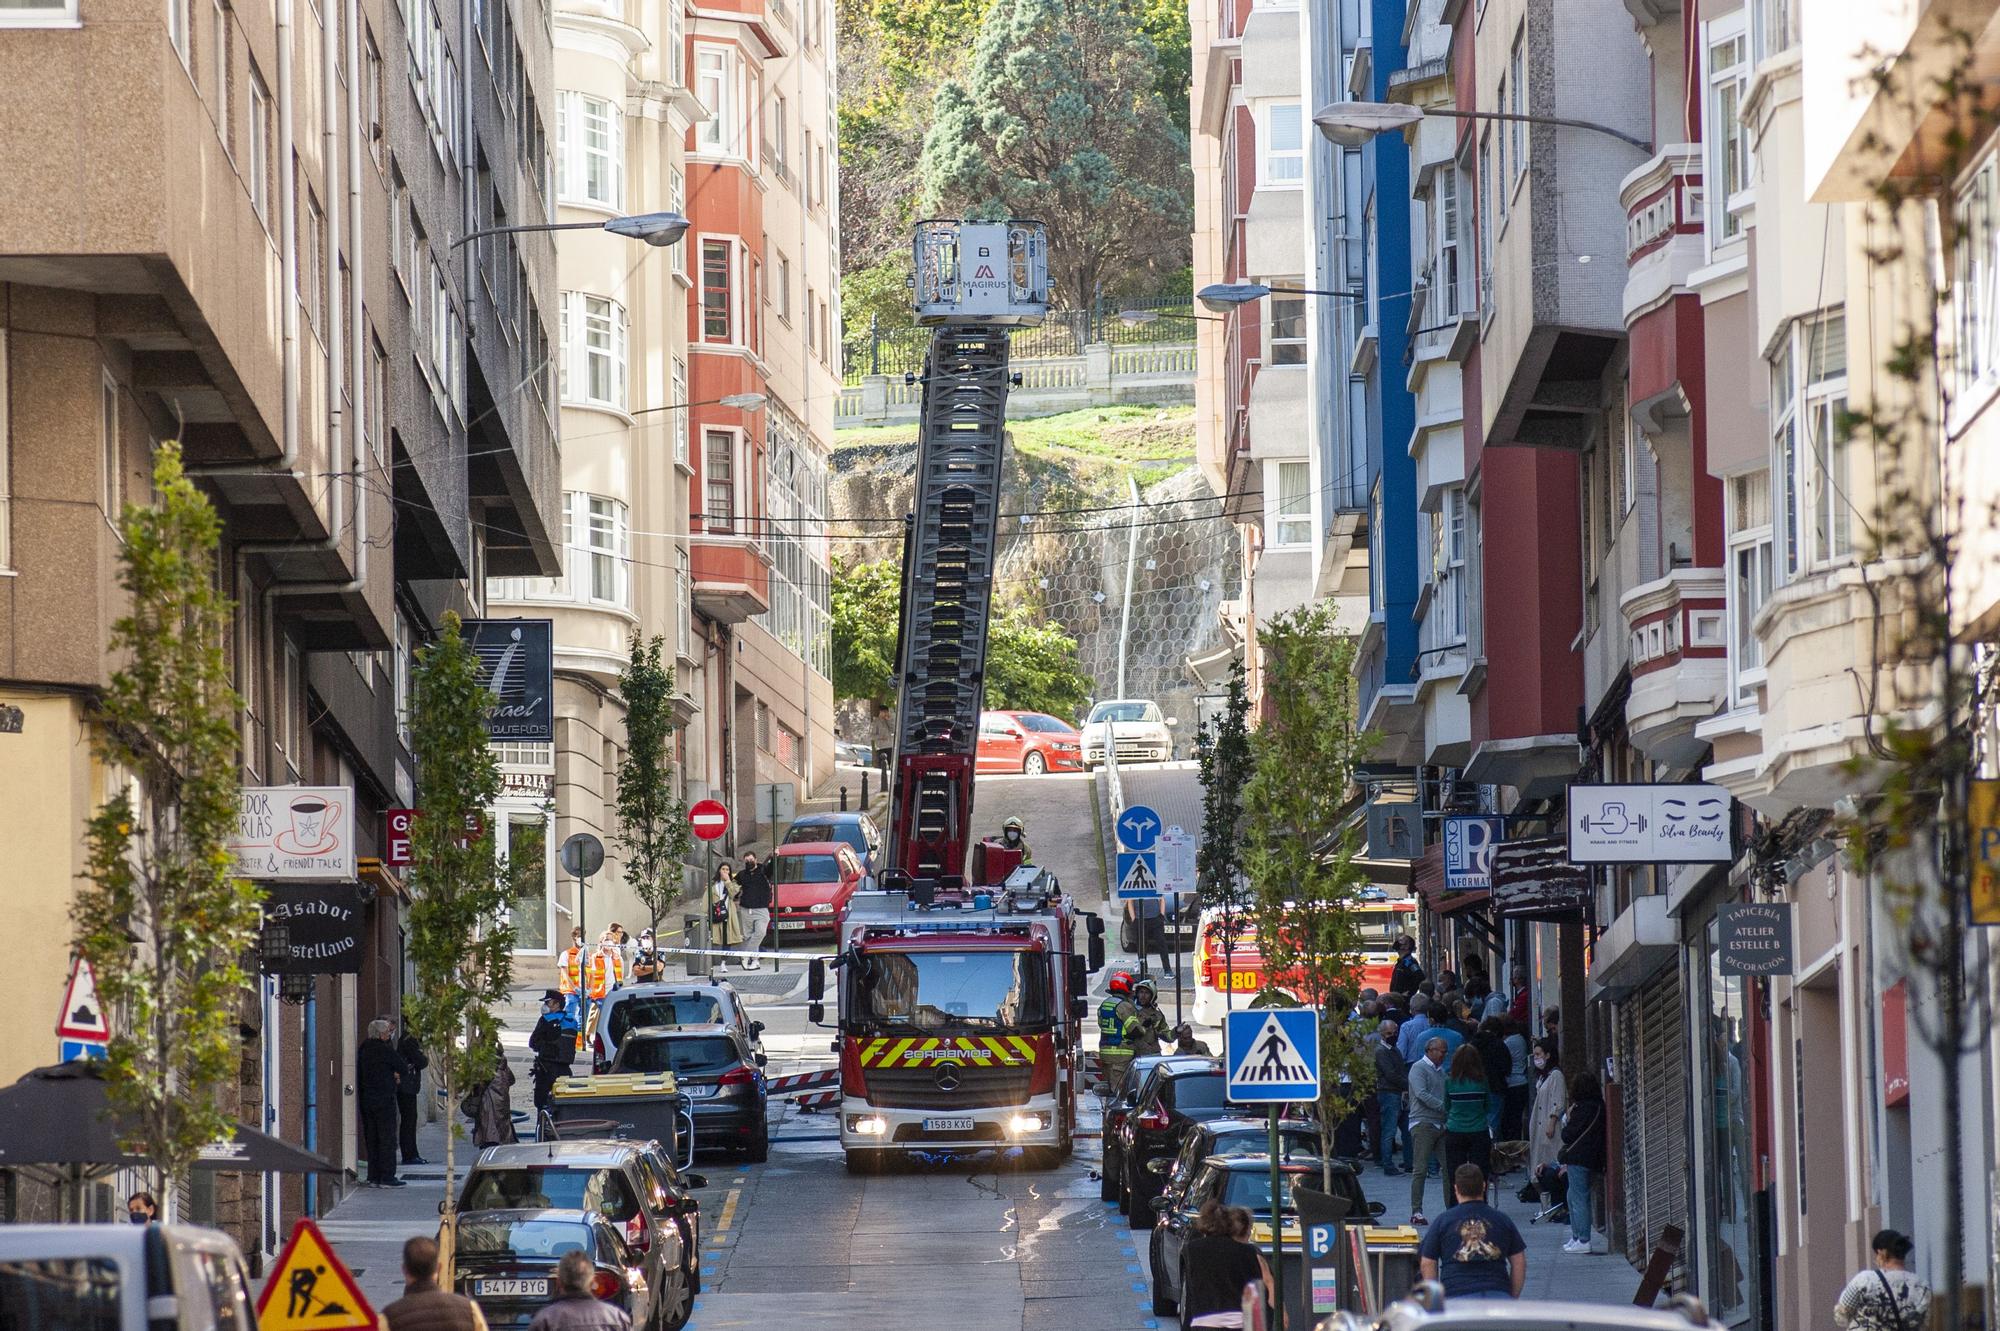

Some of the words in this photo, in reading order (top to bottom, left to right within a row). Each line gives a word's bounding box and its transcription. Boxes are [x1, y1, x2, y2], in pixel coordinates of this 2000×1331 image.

[963, 280, 1007, 289] MAGIRUS
[489, 725, 549, 734] QUEROS
[240, 794, 273, 816] EDOR
[1659, 824, 1686, 838] Silva
[1688, 824, 1724, 842] Beauty
[1447, 820, 1460, 868] TECNO
[267, 852, 279, 874] &
[283, 857, 315, 870] FRIENDLY
[317, 858, 342, 869] TALKS
[274, 900, 352, 921] Asador
[1728, 906, 1781, 922] TAPICERÍA
[1736, 927, 1775, 937] ATELIER
[287, 936, 354, 959] stellano
[1729, 941, 1770, 950] ESTELLE
[1774, 941, 1781, 950] B
[1218, 971, 1257, 991] 080
[688, 1086, 704, 1095] JRV
[930, 1120, 952, 1129] 1583
[954, 1120, 972, 1129] KXG
[484, 1281, 517, 1294] 5417
[520, 1281, 545, 1294] BYG
